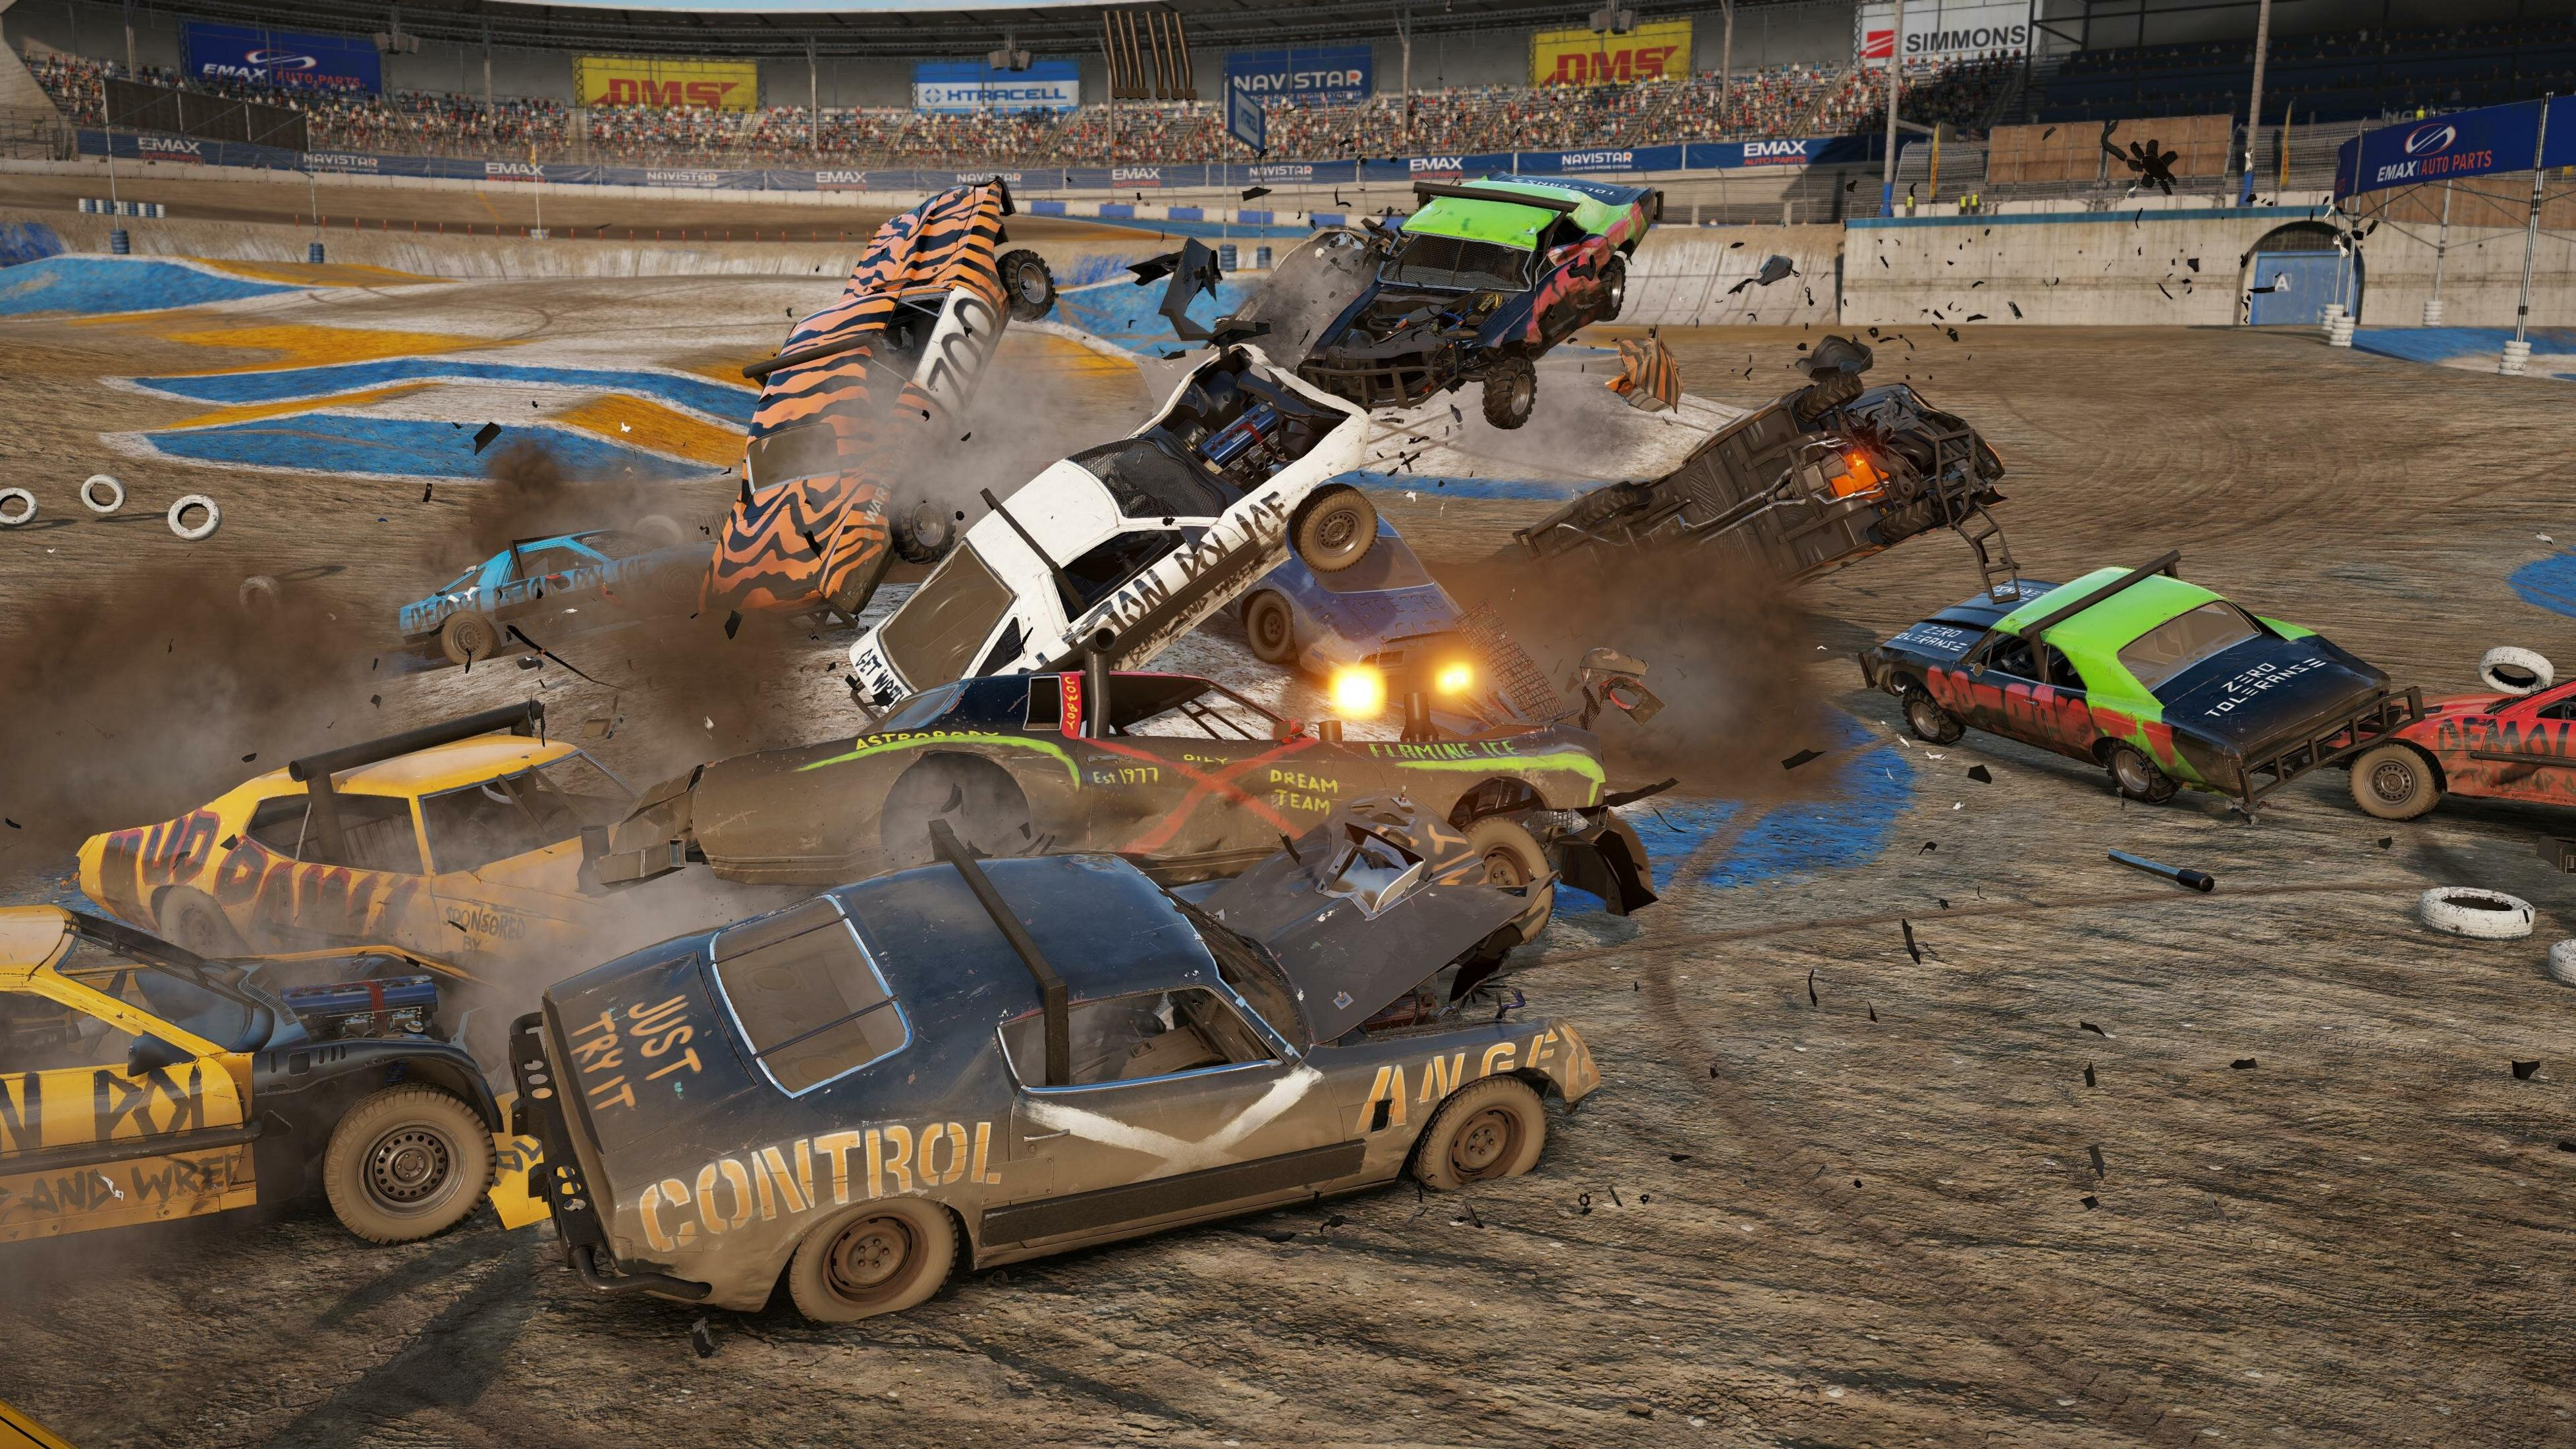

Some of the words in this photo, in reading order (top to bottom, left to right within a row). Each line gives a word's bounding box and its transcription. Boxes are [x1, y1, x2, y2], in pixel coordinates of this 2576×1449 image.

[1906, 25, 2026, 53] SIMMONS
[202, 63, 267, 78] EMAX
[276, 70, 314, 84] AUTO
[1547, 46, 1676, 85] DMS
[1234, 70, 1363, 91] NAVISTAR
[596, 78, 738, 108] DMS
[138, 137, 201, 154] EMAX
[1744, 140, 1807, 157] EMAX
[303, 153, 378, 167] NAVISTAR
[1410, 157, 1462, 171] EMAX
[1562, 152, 1632, 165] NAVISTAR
[2376, 161, 2417, 182] EMAX
[2421, 156, 2449, 175] AUTO
[2452, 150, 2492, 171] PARTS
[485, 163, 545, 176] EMAX
[647, 172, 717, 181] NAVISTAR
[816, 171, 866, 182] EMAX
[1112, 167, 1161, 180] EMAX
[1249, 165, 1312, 177] NAVISTAR
[2275, 275, 2289, 290] A
[1896, 632, 1968, 651] OLERANSE
[1922, 626, 1963, 638] ZERO
[856, 648, 883, 676] GET
[2205, 658, 2327, 717] TOLERANSE
[2220, 663, 2277, 693] ZERO
[1184, 754, 1228, 765] OILY
[1369, 743, 1477, 760] FLAMING
[1479, 741, 1521, 757] ICE
[1093, 771, 1116, 784] Est
[1118, 767, 1159, 784] 1977
[1270, 769, 1338, 794] DREAM
[1274, 789, 1330, 816] TEAM
[463, 936, 481, 952] BY
[570, 1011, 624, 1074] TRY
[628, 995, 702, 1081] JUST
[588, 1075, 636, 1110] IT
[639, 1122, 1002, 1252] CONTROL
